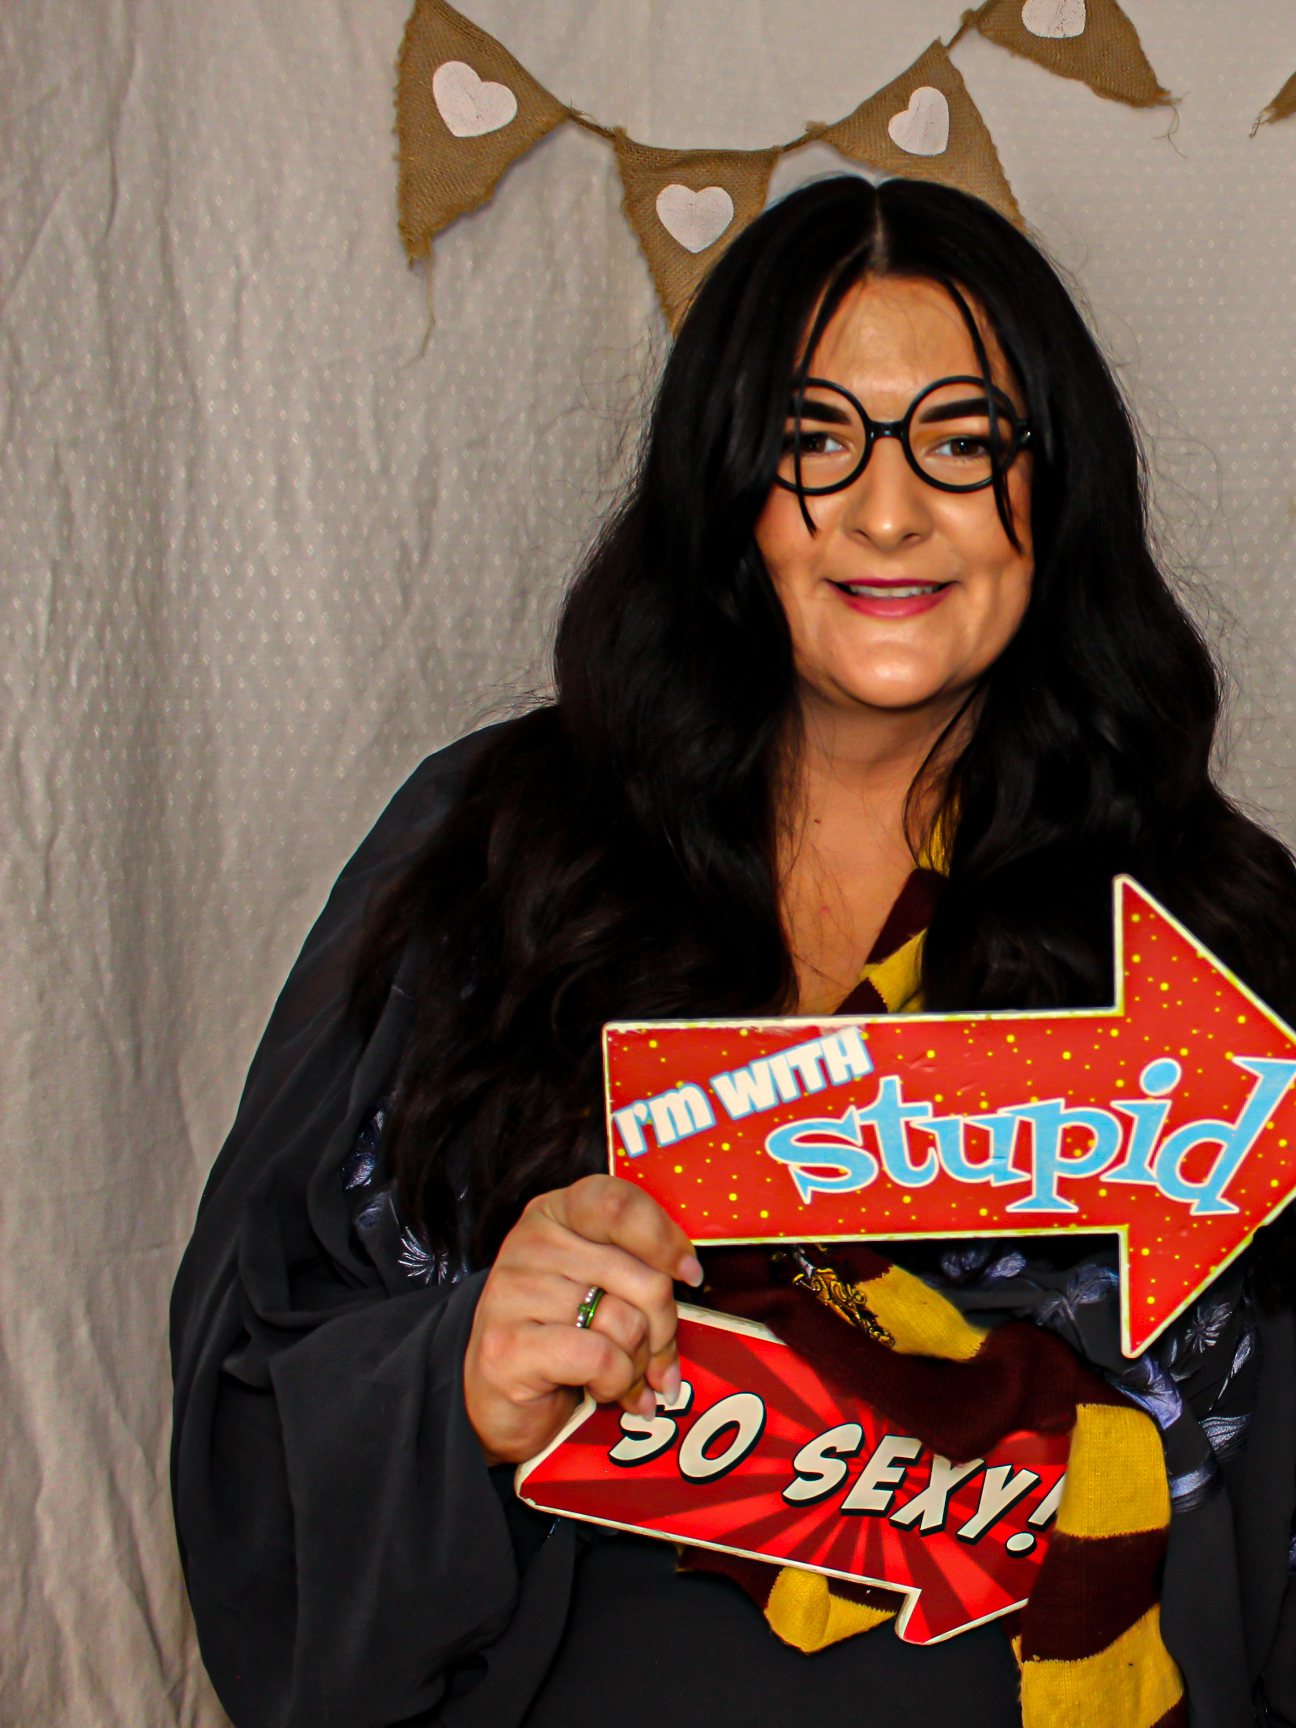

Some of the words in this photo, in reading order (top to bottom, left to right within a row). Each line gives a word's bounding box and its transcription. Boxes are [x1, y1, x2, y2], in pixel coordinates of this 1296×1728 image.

[612, 1081, 716, 1158] I'm
[710, 1026, 876, 1121] WITH
[608, 1380, 768, 1484] SO
